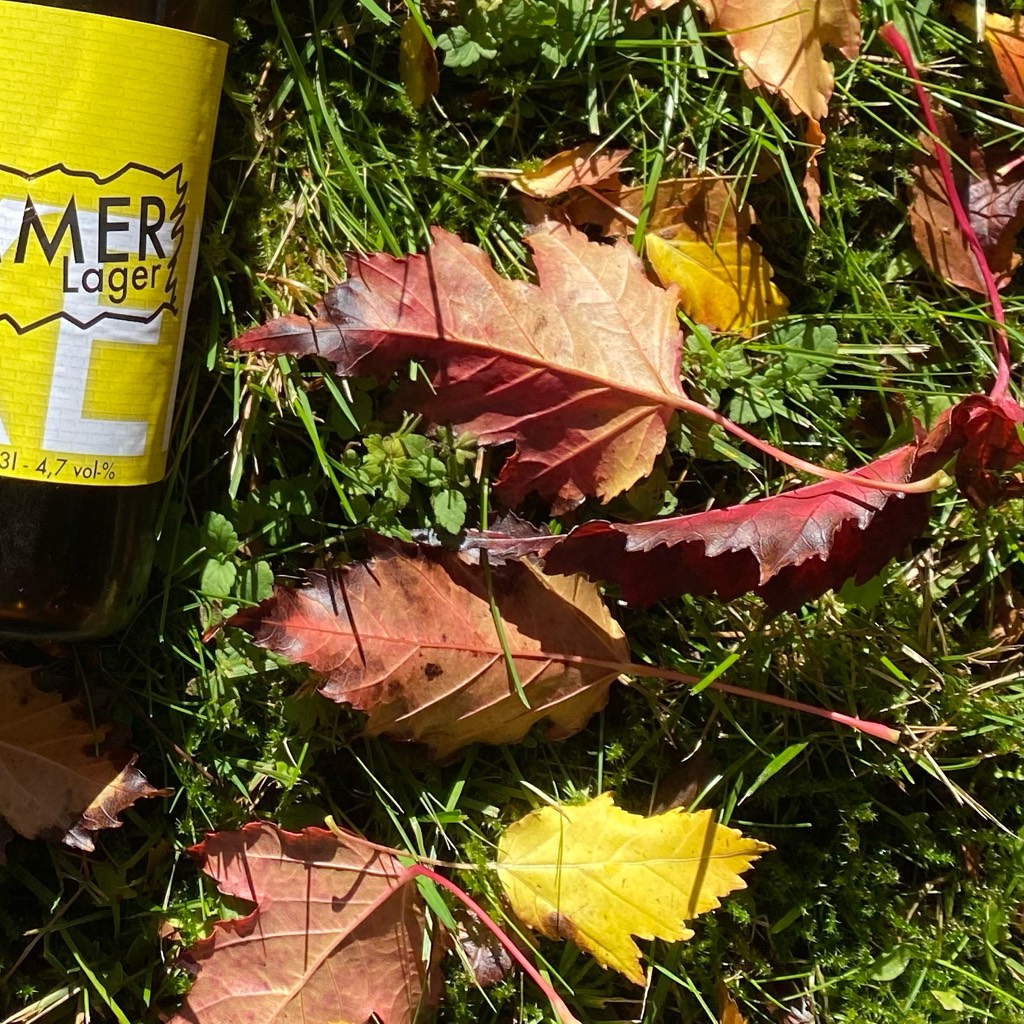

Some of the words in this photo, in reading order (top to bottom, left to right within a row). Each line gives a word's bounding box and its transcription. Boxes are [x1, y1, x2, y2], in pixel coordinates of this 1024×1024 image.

[62, 256, 162, 304] Lager
[35, 457, 68, 479] 4,7
[73, 460, 116, 480] vol-%
